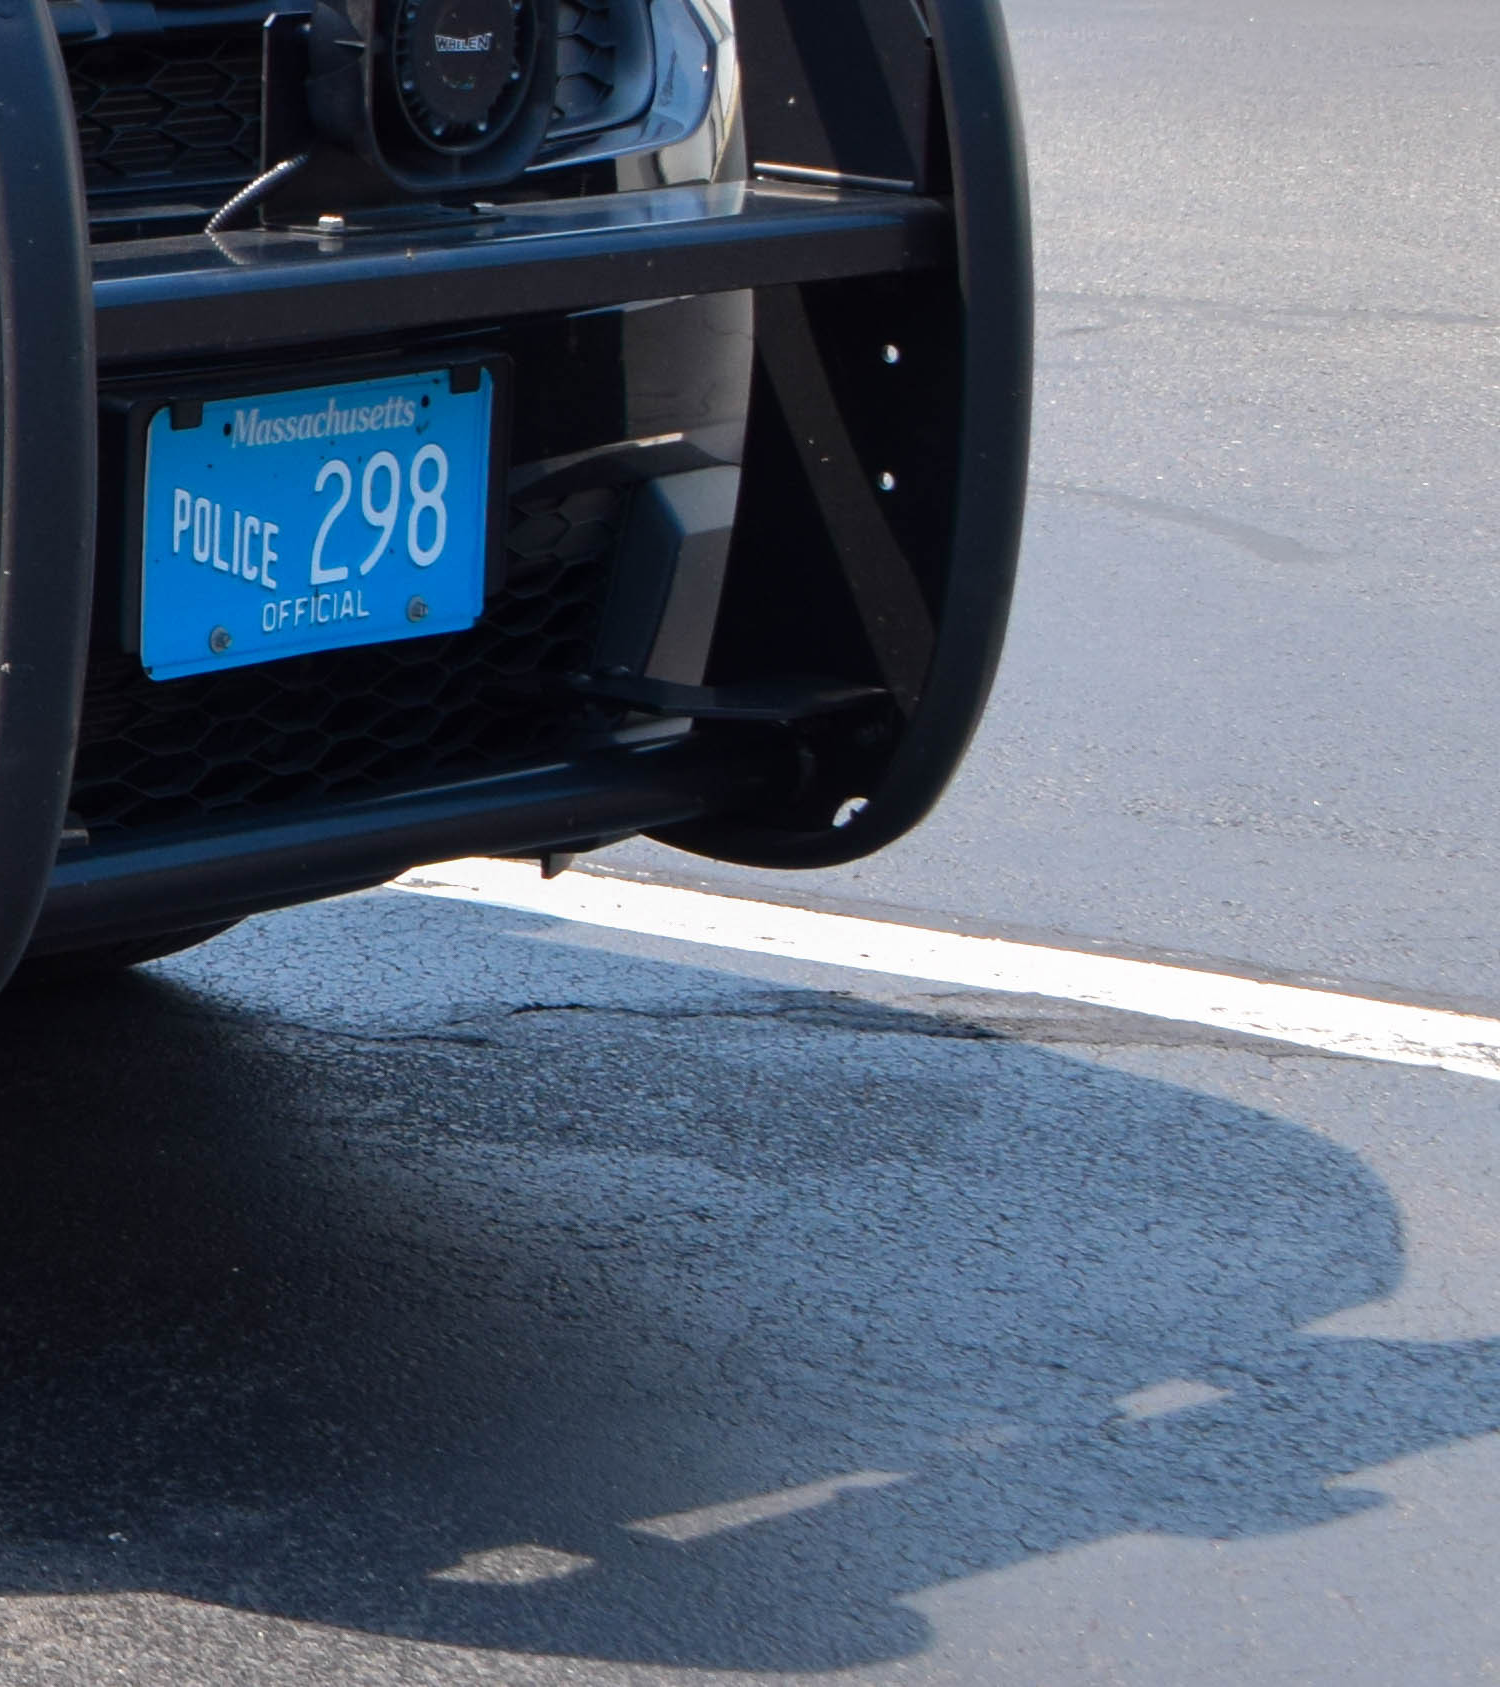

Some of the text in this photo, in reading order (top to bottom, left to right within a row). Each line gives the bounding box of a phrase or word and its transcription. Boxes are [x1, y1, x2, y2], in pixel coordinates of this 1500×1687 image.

[230, 396, 416, 448] Massachusetts
[173, 443, 450, 590] POLICE 298
[261, 589, 371, 632] OFFICIAL
